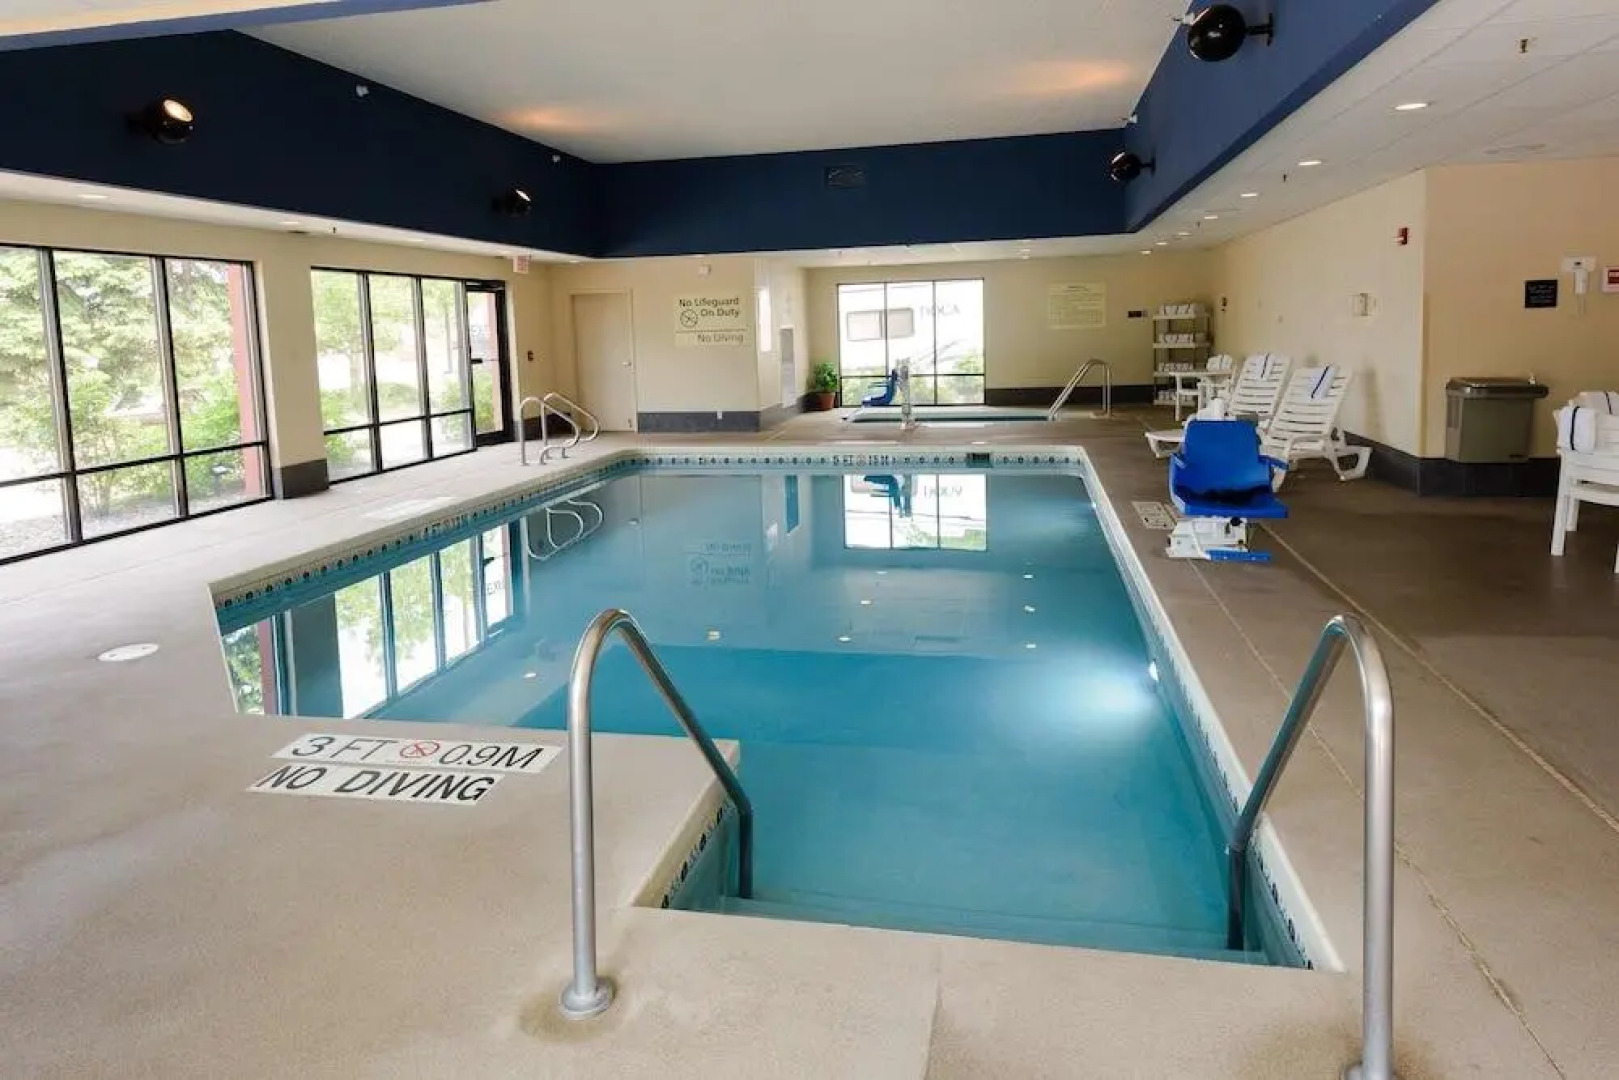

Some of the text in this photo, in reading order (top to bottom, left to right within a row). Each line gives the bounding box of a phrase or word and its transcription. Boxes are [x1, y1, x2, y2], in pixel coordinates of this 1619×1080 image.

[679, 297, 740, 308] No Lifeguard
[700, 307, 740, 318] On Duty
[697, 334, 712, 343] No
[291, 736, 545, 769] 3 FT 0.9M
[255, 765, 496, 801] NO DIVING
